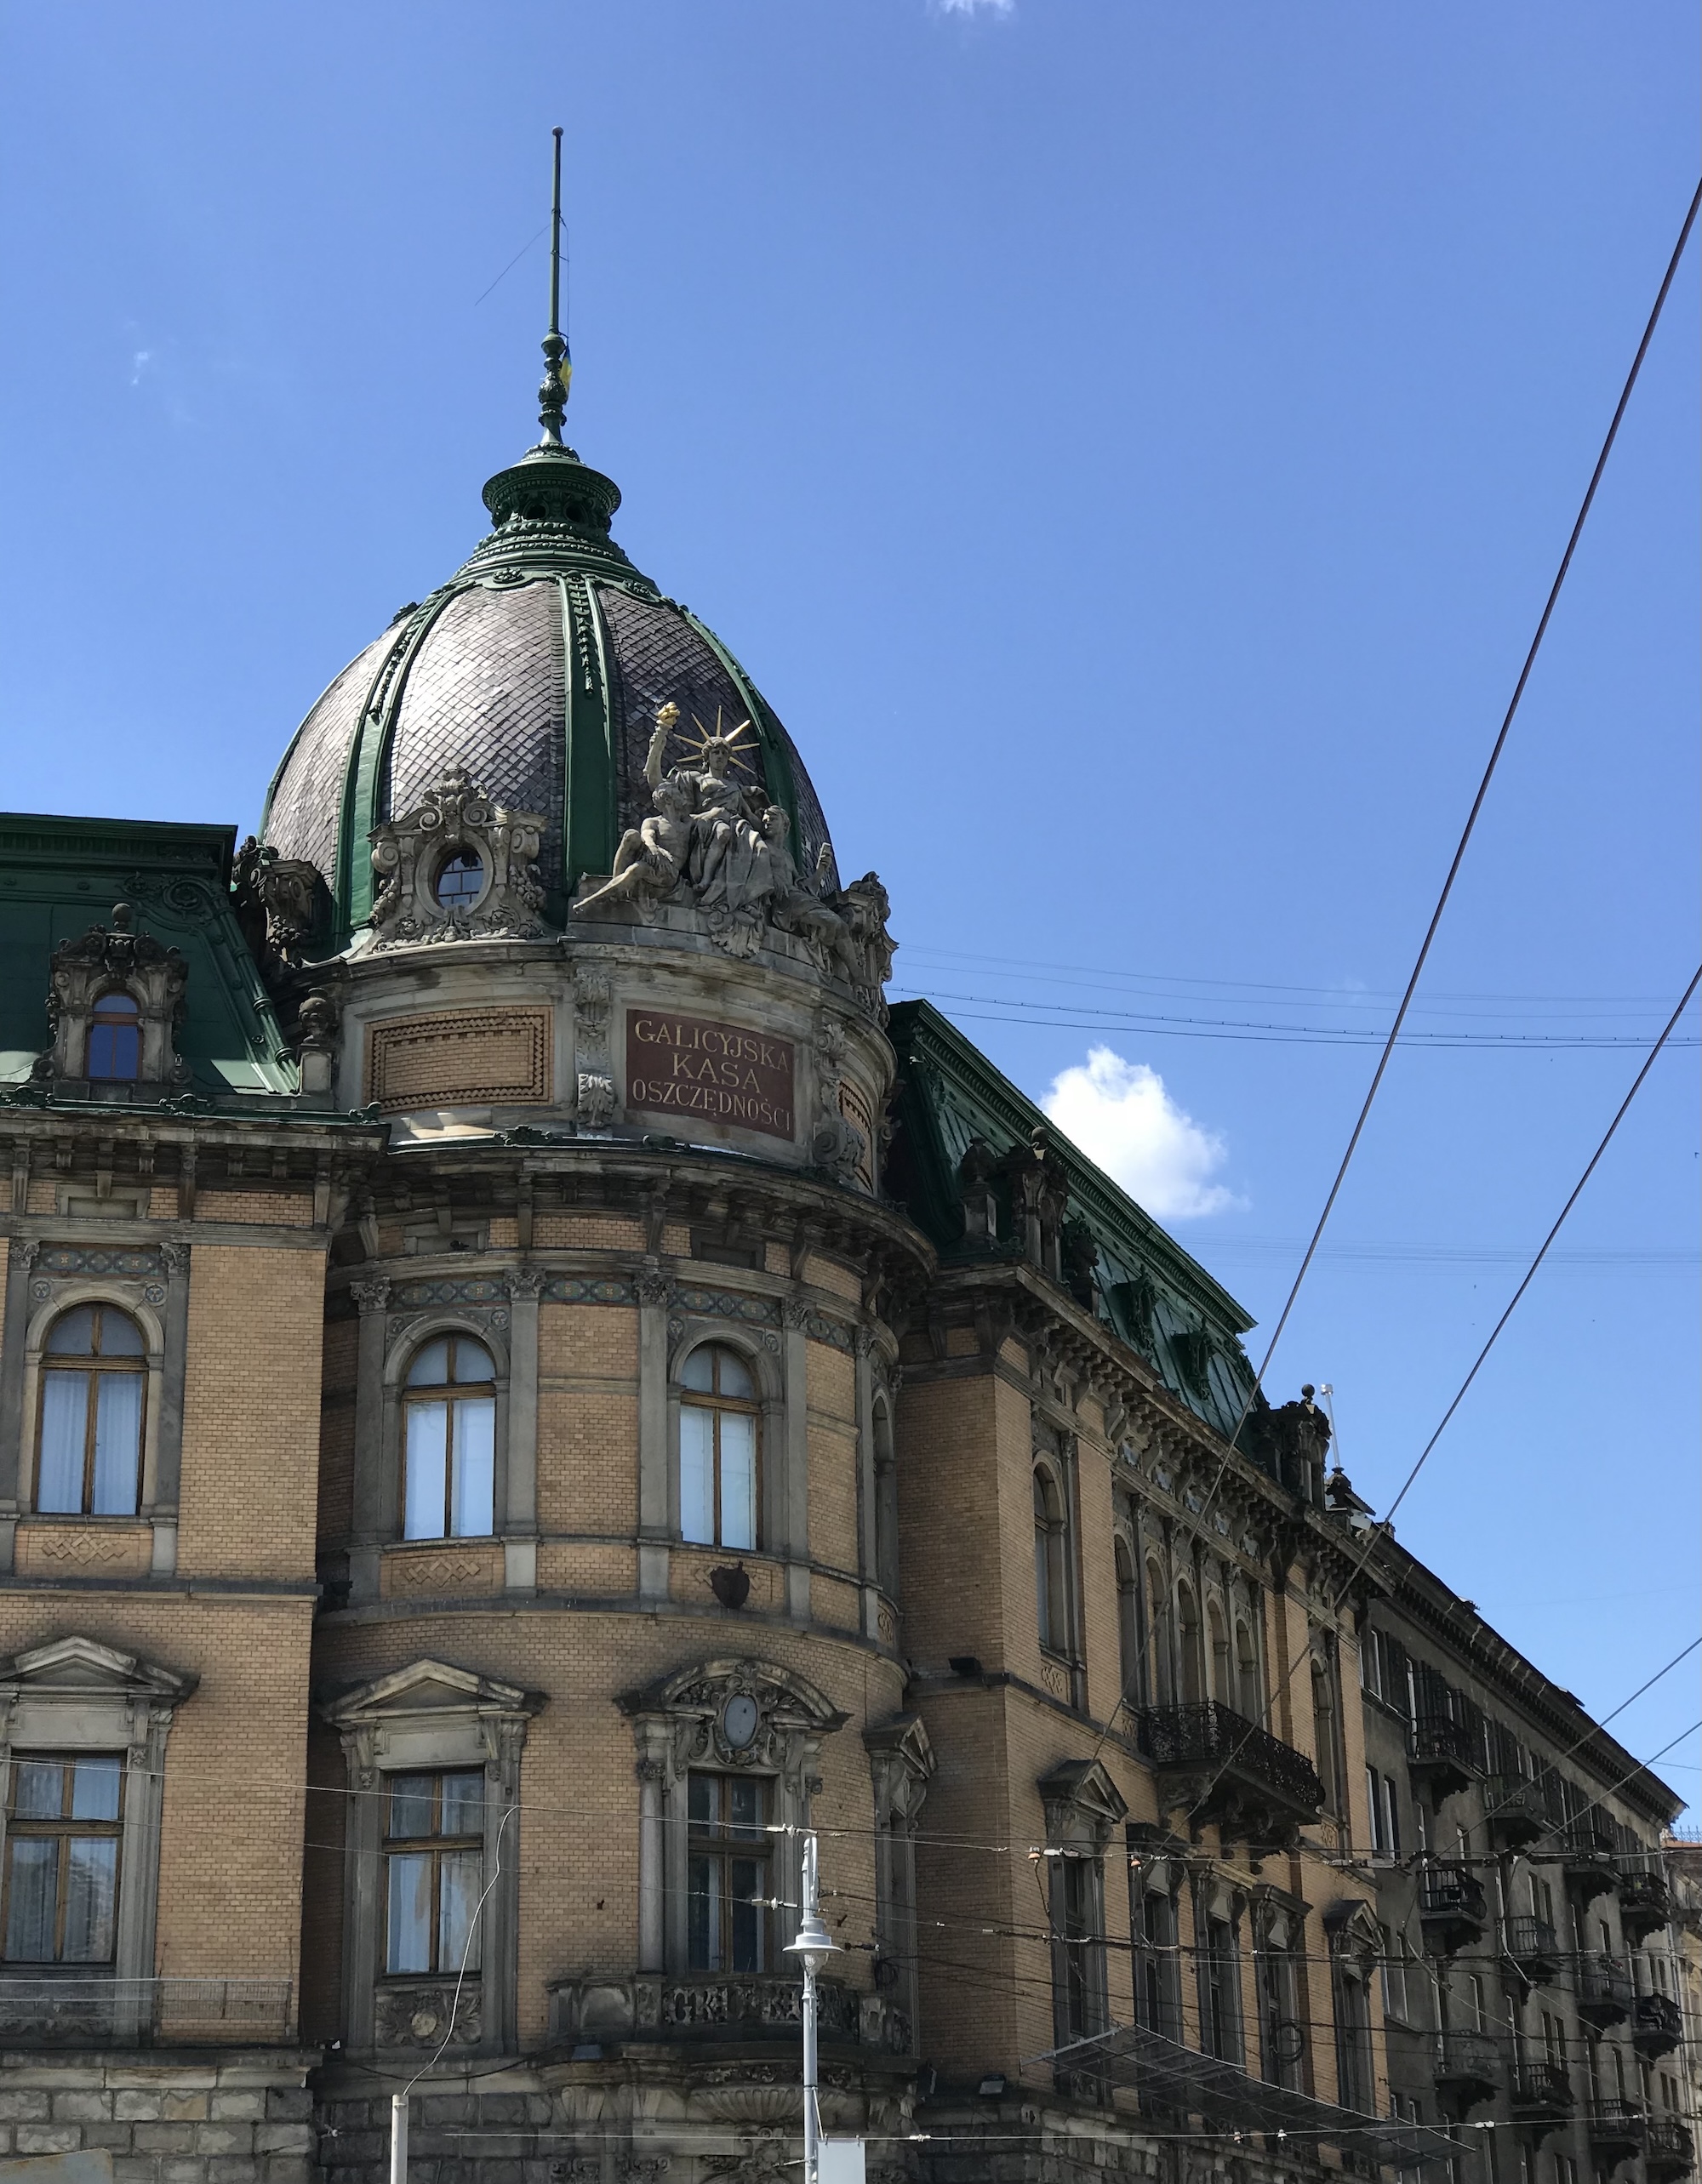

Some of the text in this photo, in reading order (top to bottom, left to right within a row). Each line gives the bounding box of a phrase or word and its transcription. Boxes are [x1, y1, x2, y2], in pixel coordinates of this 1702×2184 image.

[635, 1020, 789, 1072] GALICYJSKA
[672, 1052, 762, 1094] KASA
[632, 1079, 791, 1131] OSZCZĘDNOŚCI
